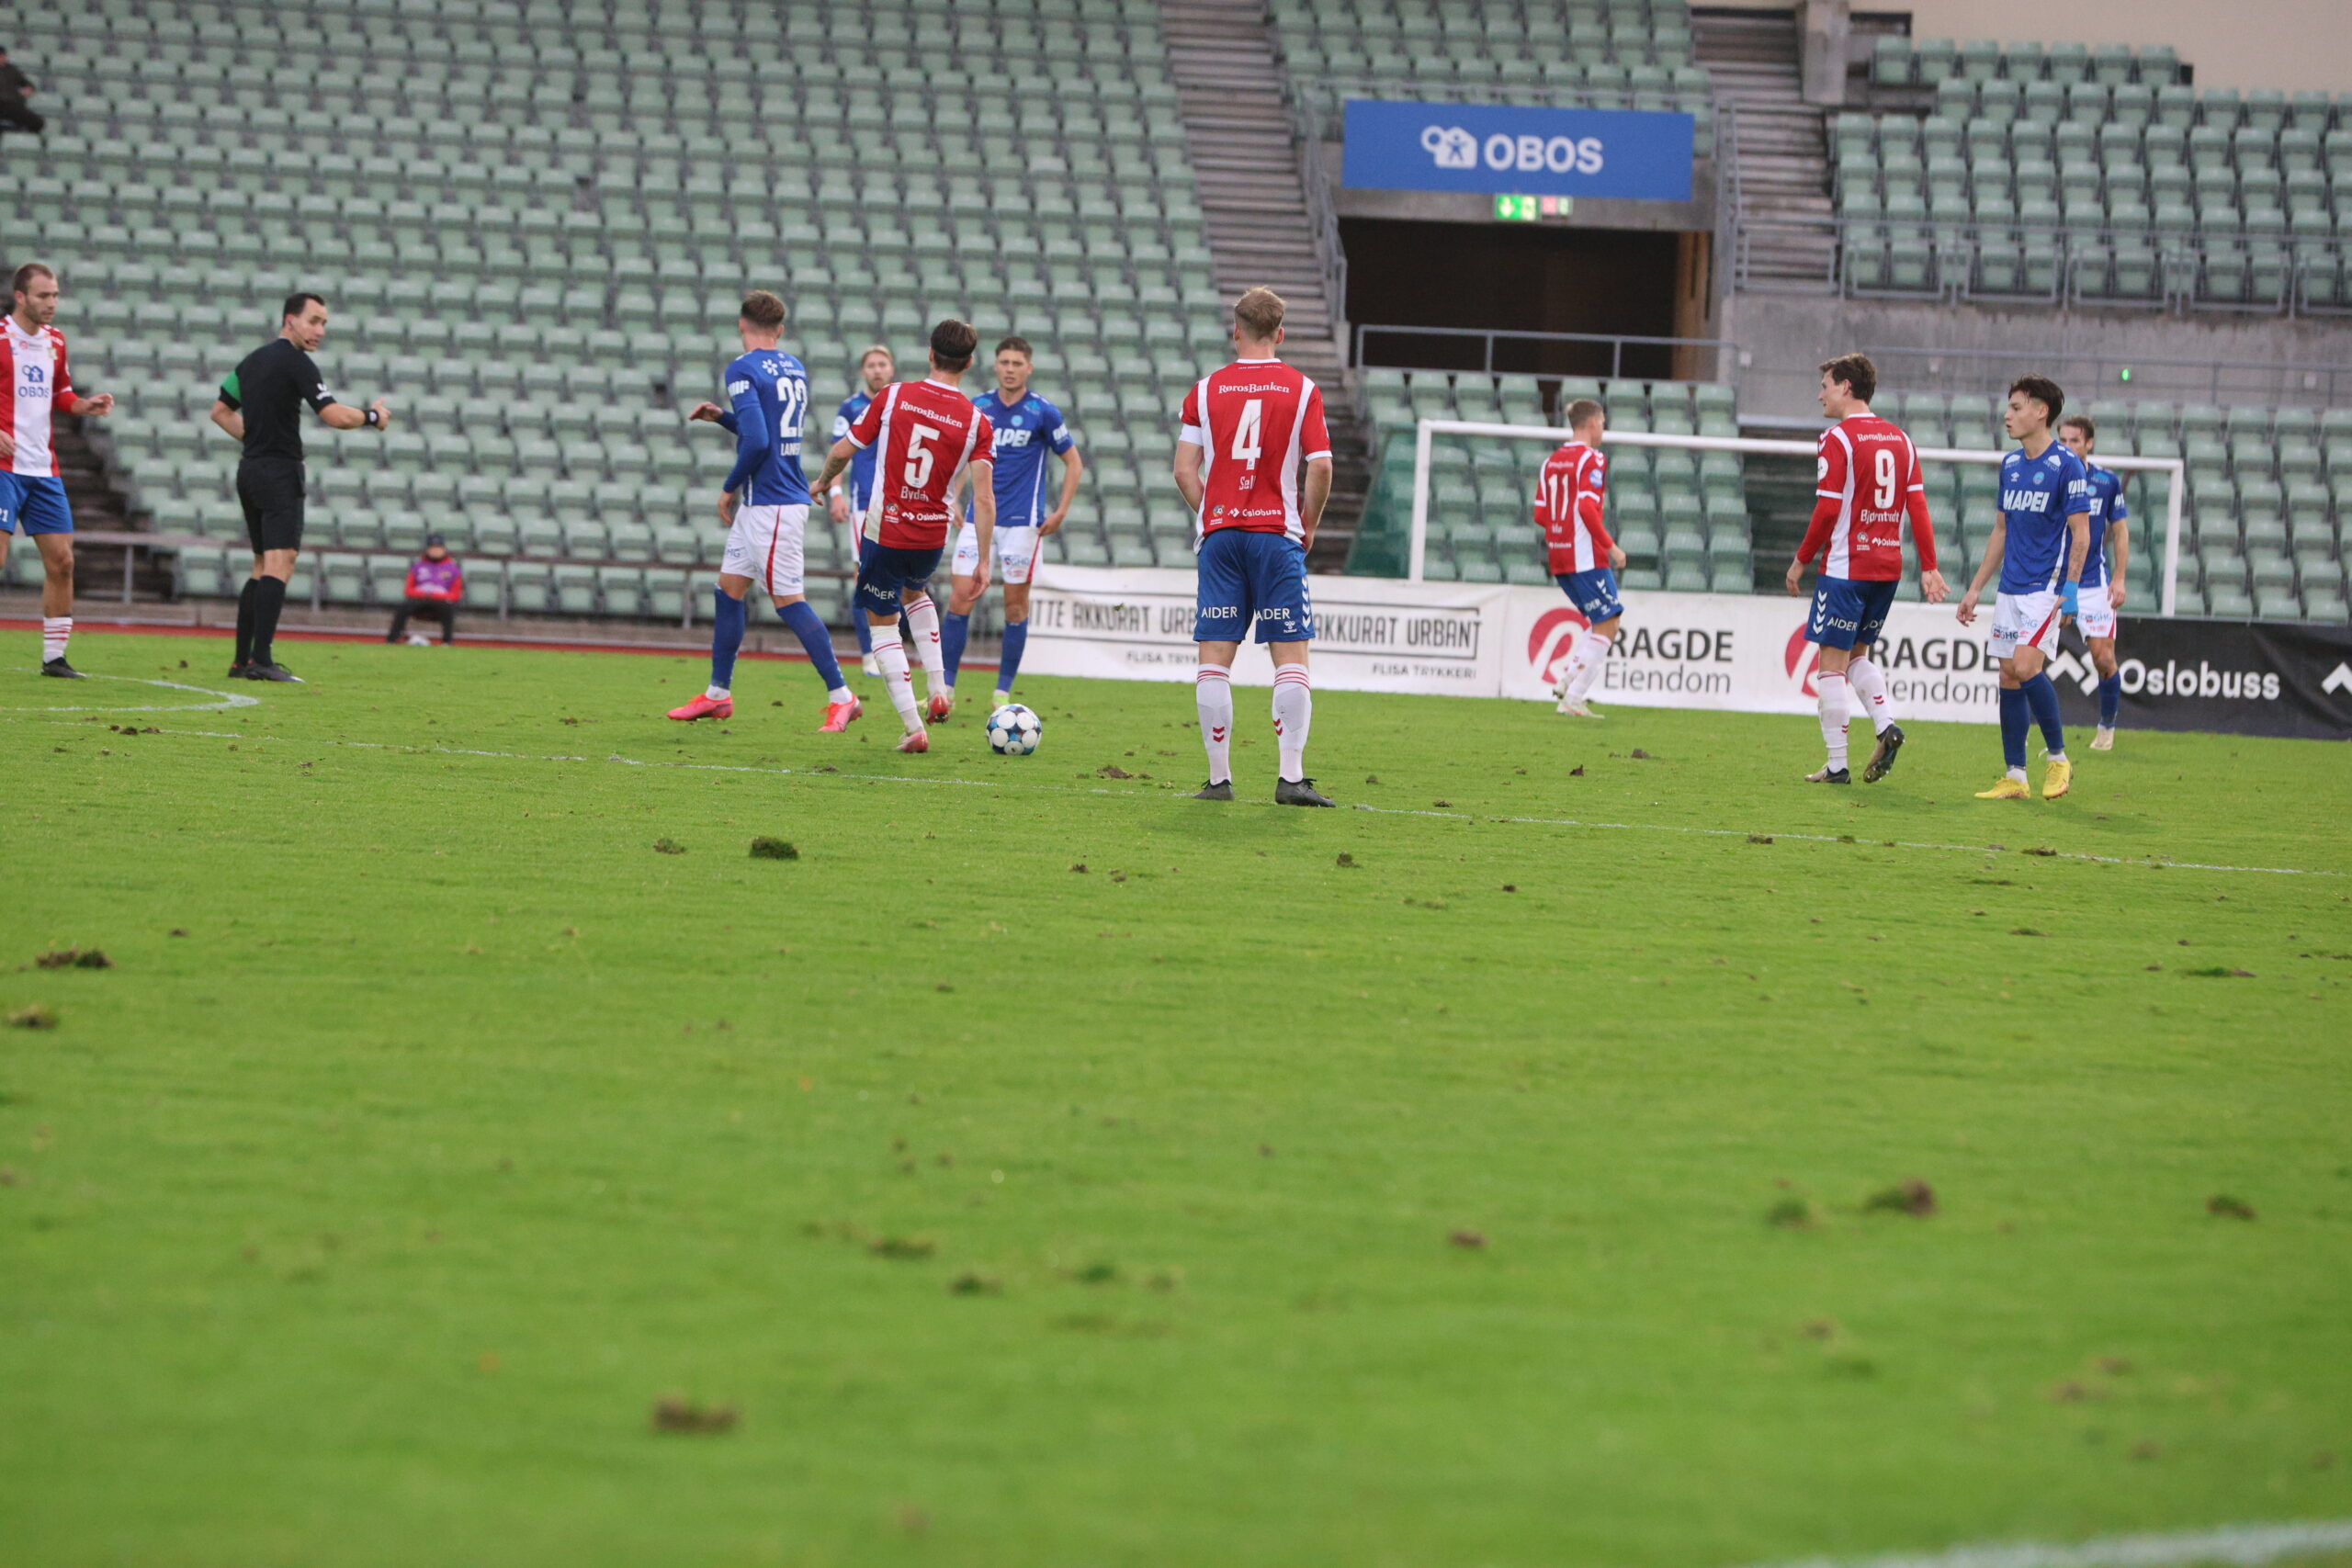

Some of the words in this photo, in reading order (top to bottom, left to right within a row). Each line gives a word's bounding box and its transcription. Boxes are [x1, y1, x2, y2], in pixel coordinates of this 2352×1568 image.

[1484, 132, 1604, 175] OBOS
[18, 386, 50, 398] OBOS
[1218, 382, 1290, 394] RørosBanken
[776, 377, 808, 438] 22
[899, 400, 963, 428] RørosBanken
[993, 427, 1032, 447] APEI
[1231, 399, 1262, 470] 4
[904, 423, 941, 489] 5
[1874, 448, 1896, 509] 9
[1548, 473, 1569, 521] 11
[2003, 490, 2050, 513] MAPEI
[863, 583, 895, 600] AIDER
[1029, 600, 1063, 627] ITTE
[1072, 602, 1150, 635] AKKURAT
[1201, 606, 1238, 618] AIDER
[1827, 616, 1858, 632] AIDER
[1315, 613, 1398, 645] AKKURAT
[1607, 626, 1735, 663] RAGDE
[1125, 650, 1162, 664] FLISA
[1372, 661, 1408, 675] FLISA
[1413, 666, 1477, 679] TRYKKERI
[1604, 660, 1732, 694] Eiendom
[1884, 672, 1999, 705] iendom
[2119, 658, 2281, 701] Oslobuss
